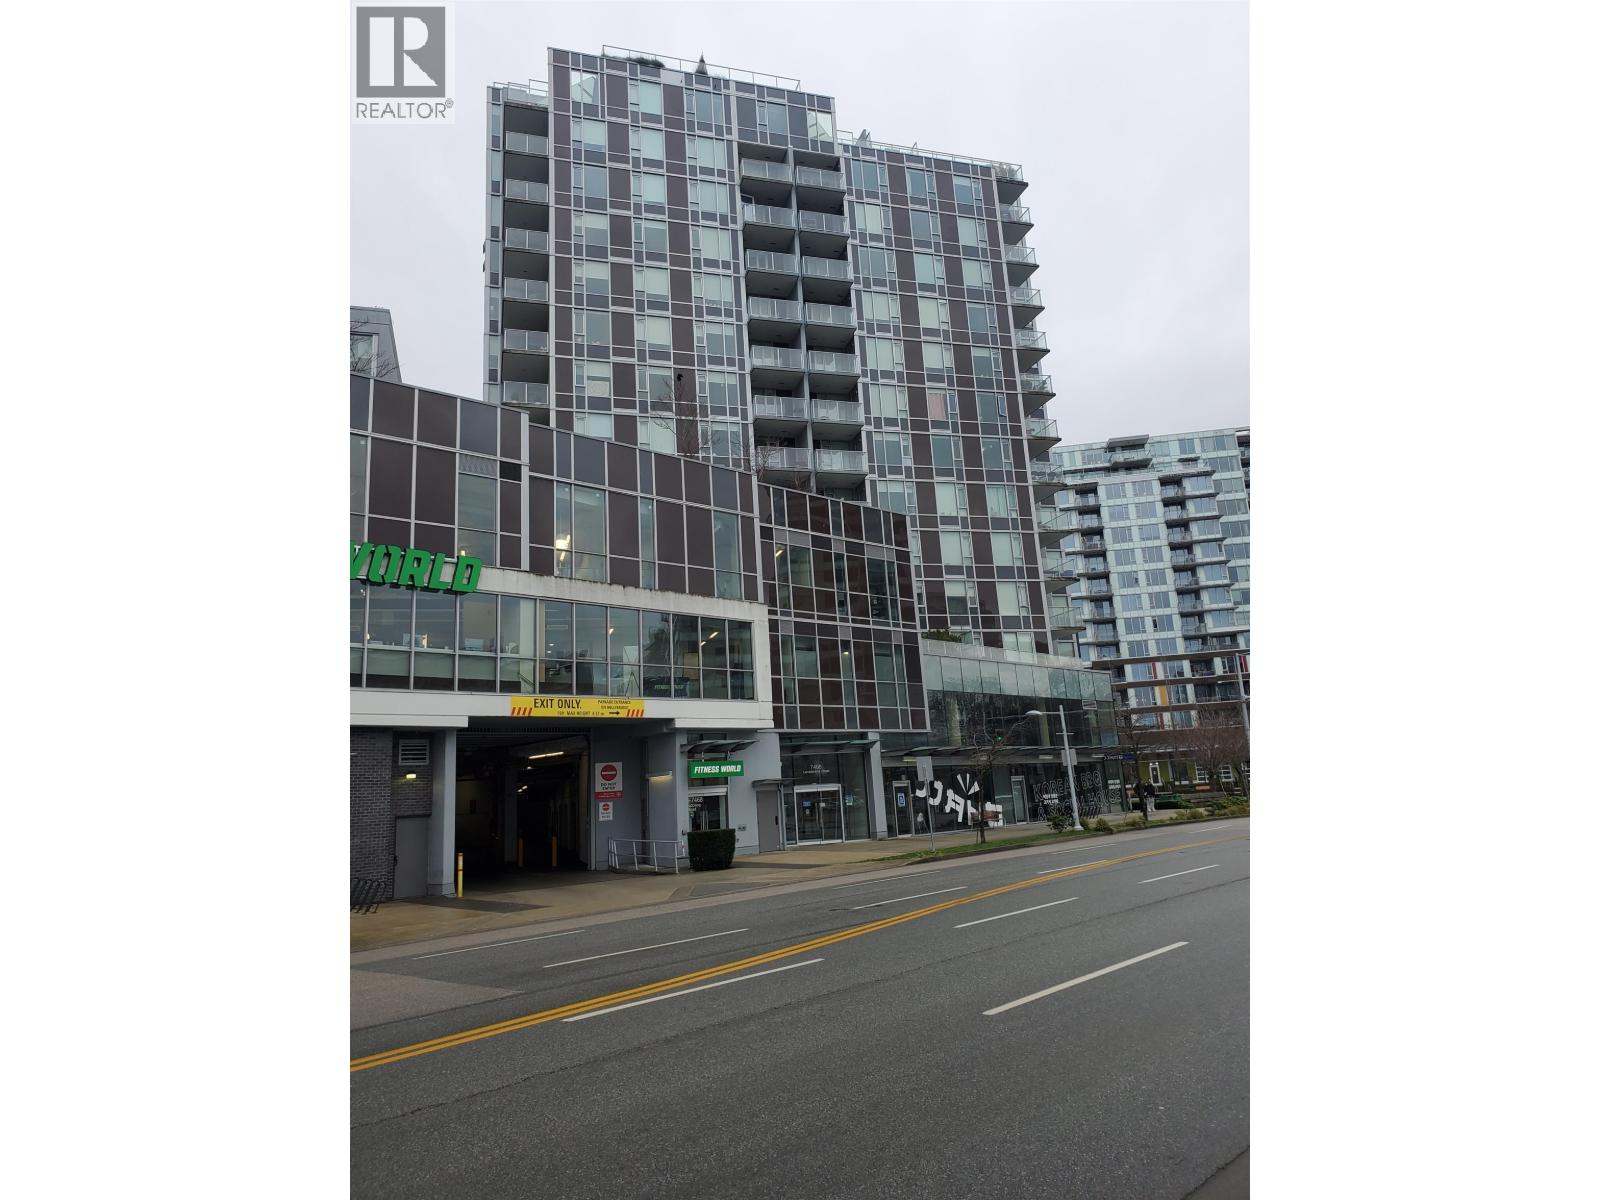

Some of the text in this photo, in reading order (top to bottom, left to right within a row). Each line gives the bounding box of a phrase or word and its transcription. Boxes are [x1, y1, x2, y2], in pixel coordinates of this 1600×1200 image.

[533, 698, 582, 710] EXIT ONLY.
[694, 764, 742, 774] FITNESS WORLD
